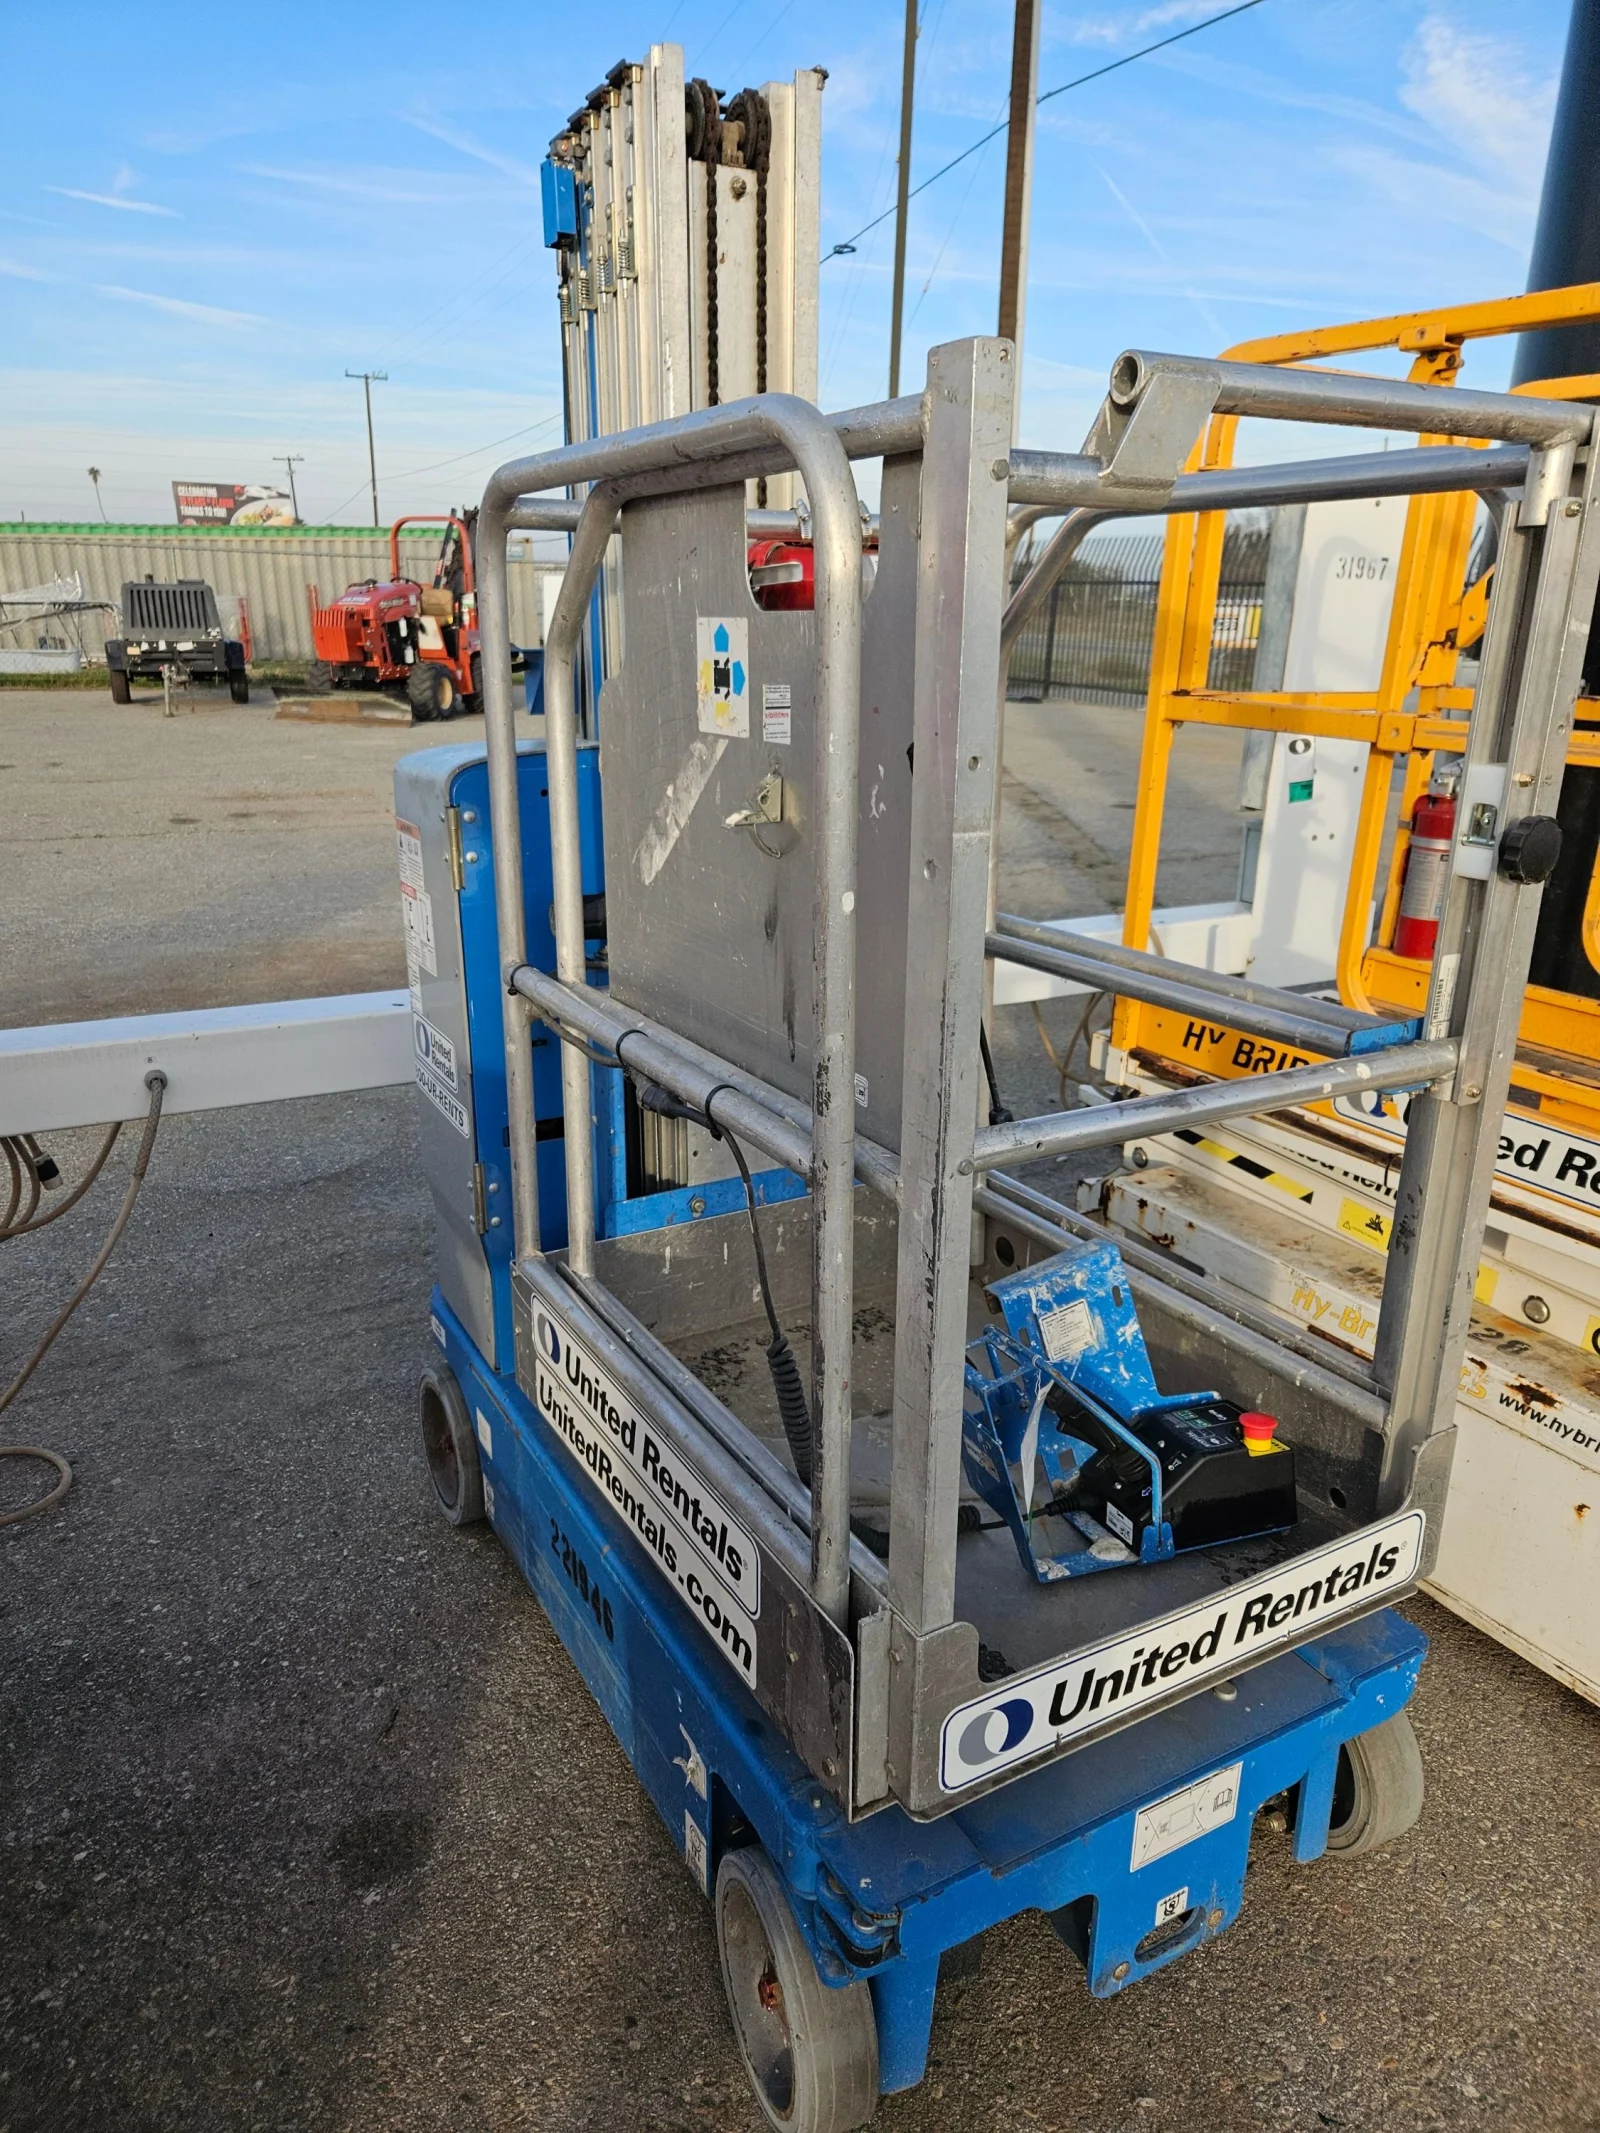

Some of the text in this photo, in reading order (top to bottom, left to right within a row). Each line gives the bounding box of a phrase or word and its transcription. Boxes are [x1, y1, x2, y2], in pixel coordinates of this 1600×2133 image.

[178, 486, 217, 497] CELEBRATING
[180, 505, 204, 517] THANKS
[1336, 556, 1390, 581] 31967
[430, 1031, 452, 1062] United
[431, 1049, 455, 1083] Rentals
[1291, 1287, 1377, 1344] Hy-Br
[565, 1344, 743, 1582] United Rentals
[539, 1373, 753, 1673] UnitedRentals.com
[550, 1516, 615, 1643] 221946
[1048, 1542, 1401, 1727] United Rentals
